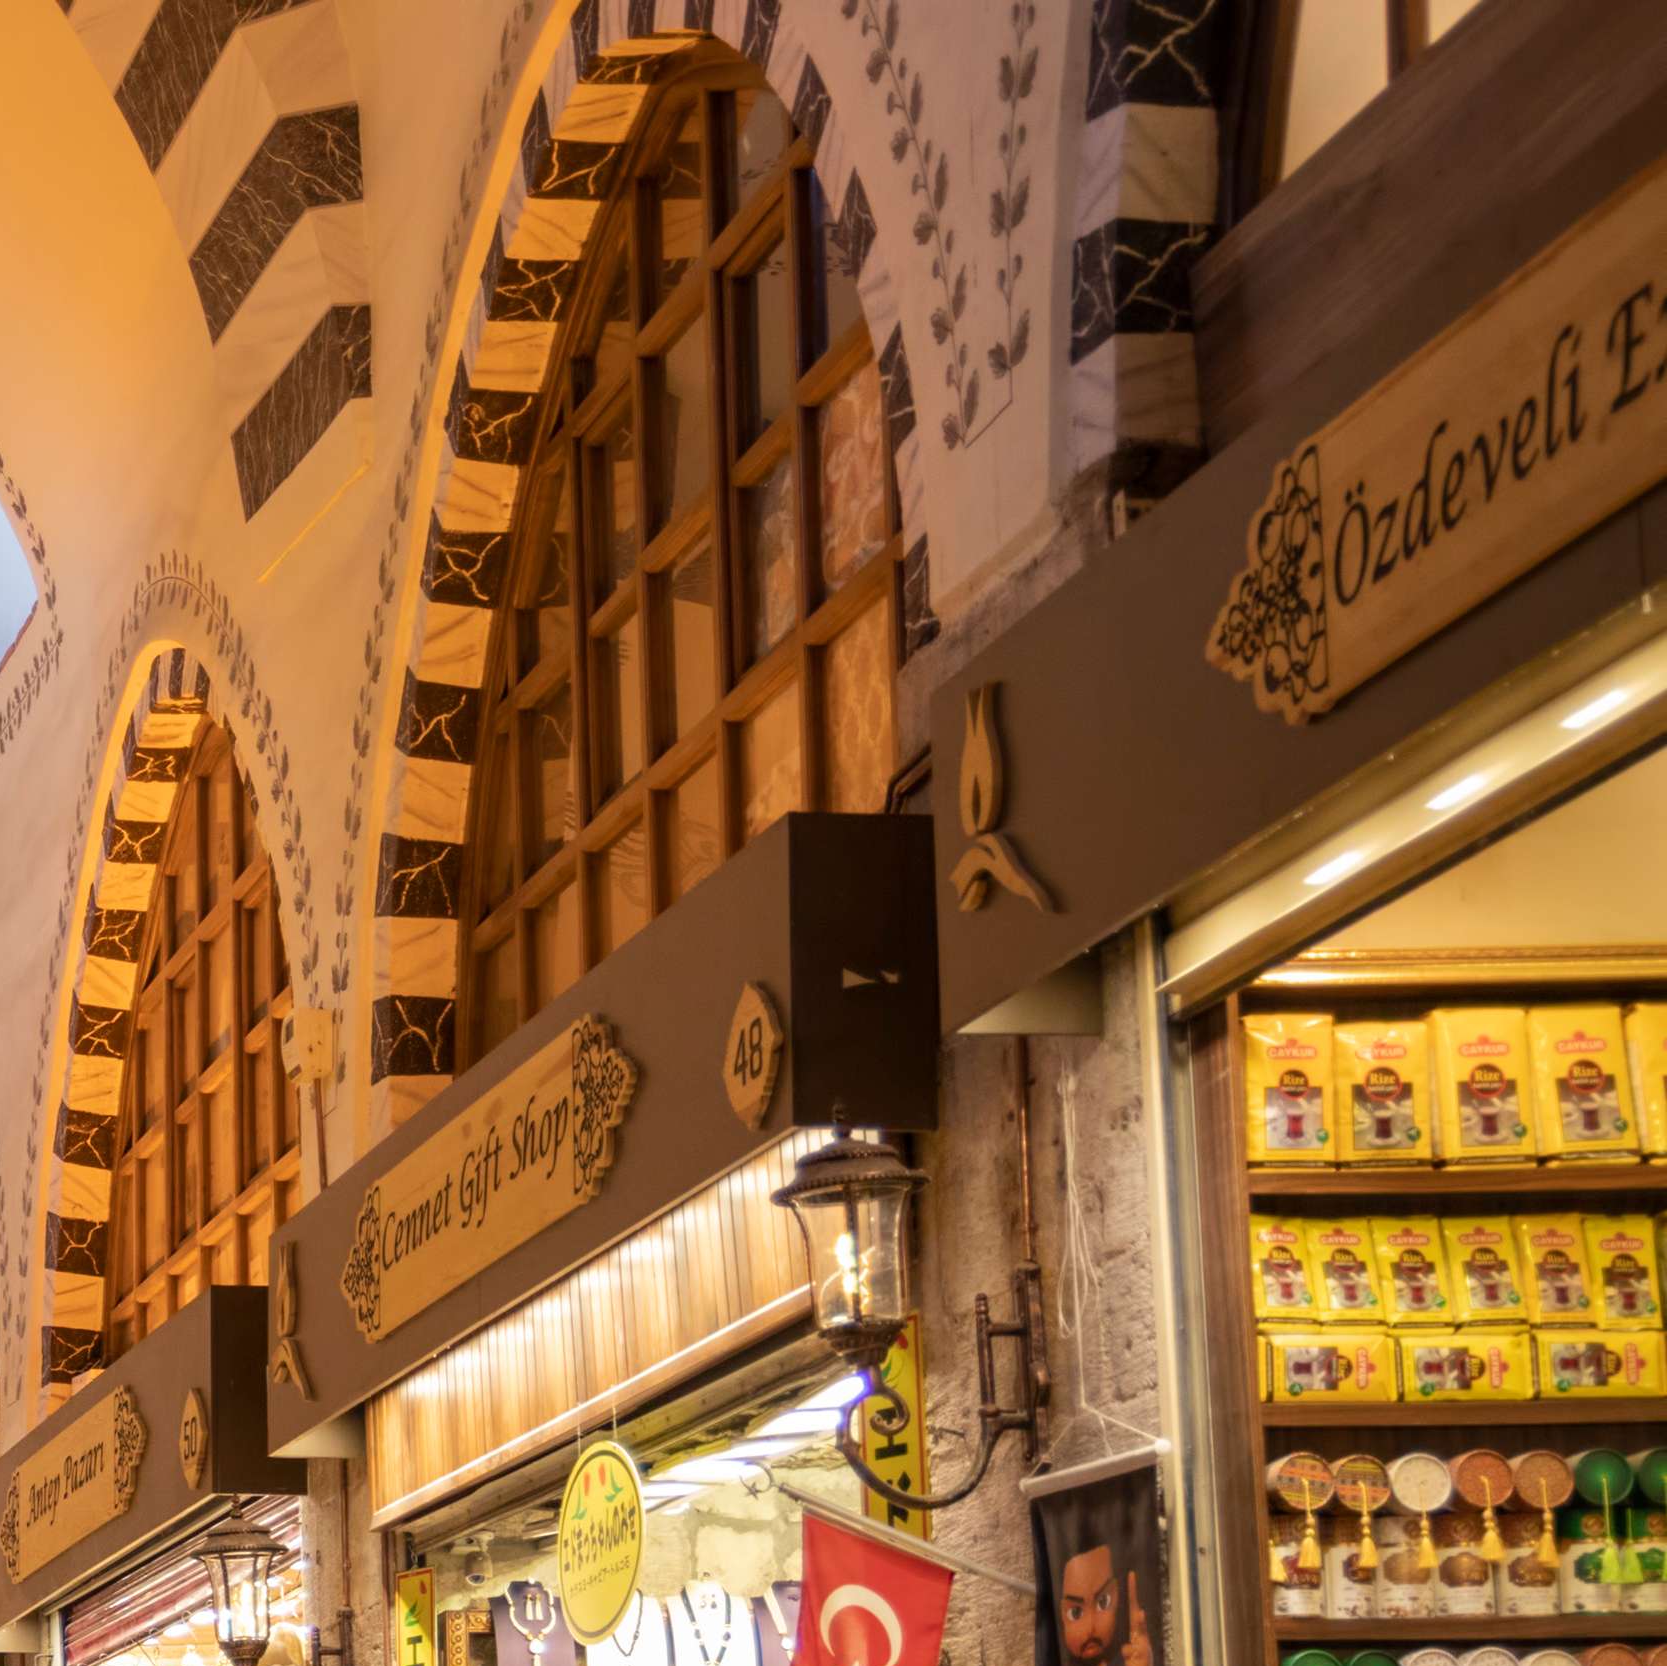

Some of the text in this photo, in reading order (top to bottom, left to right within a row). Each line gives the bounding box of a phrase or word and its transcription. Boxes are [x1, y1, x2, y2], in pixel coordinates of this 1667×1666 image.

[1333, 280, 1667, 607] Özdeveli E
[732, 1016, 764, 1087] 48
[380, 1094, 570, 1271] Cennet Gift Shop
[183, 1420, 198, 1458] 50
[26, 1474, 61, 1529] Antep
